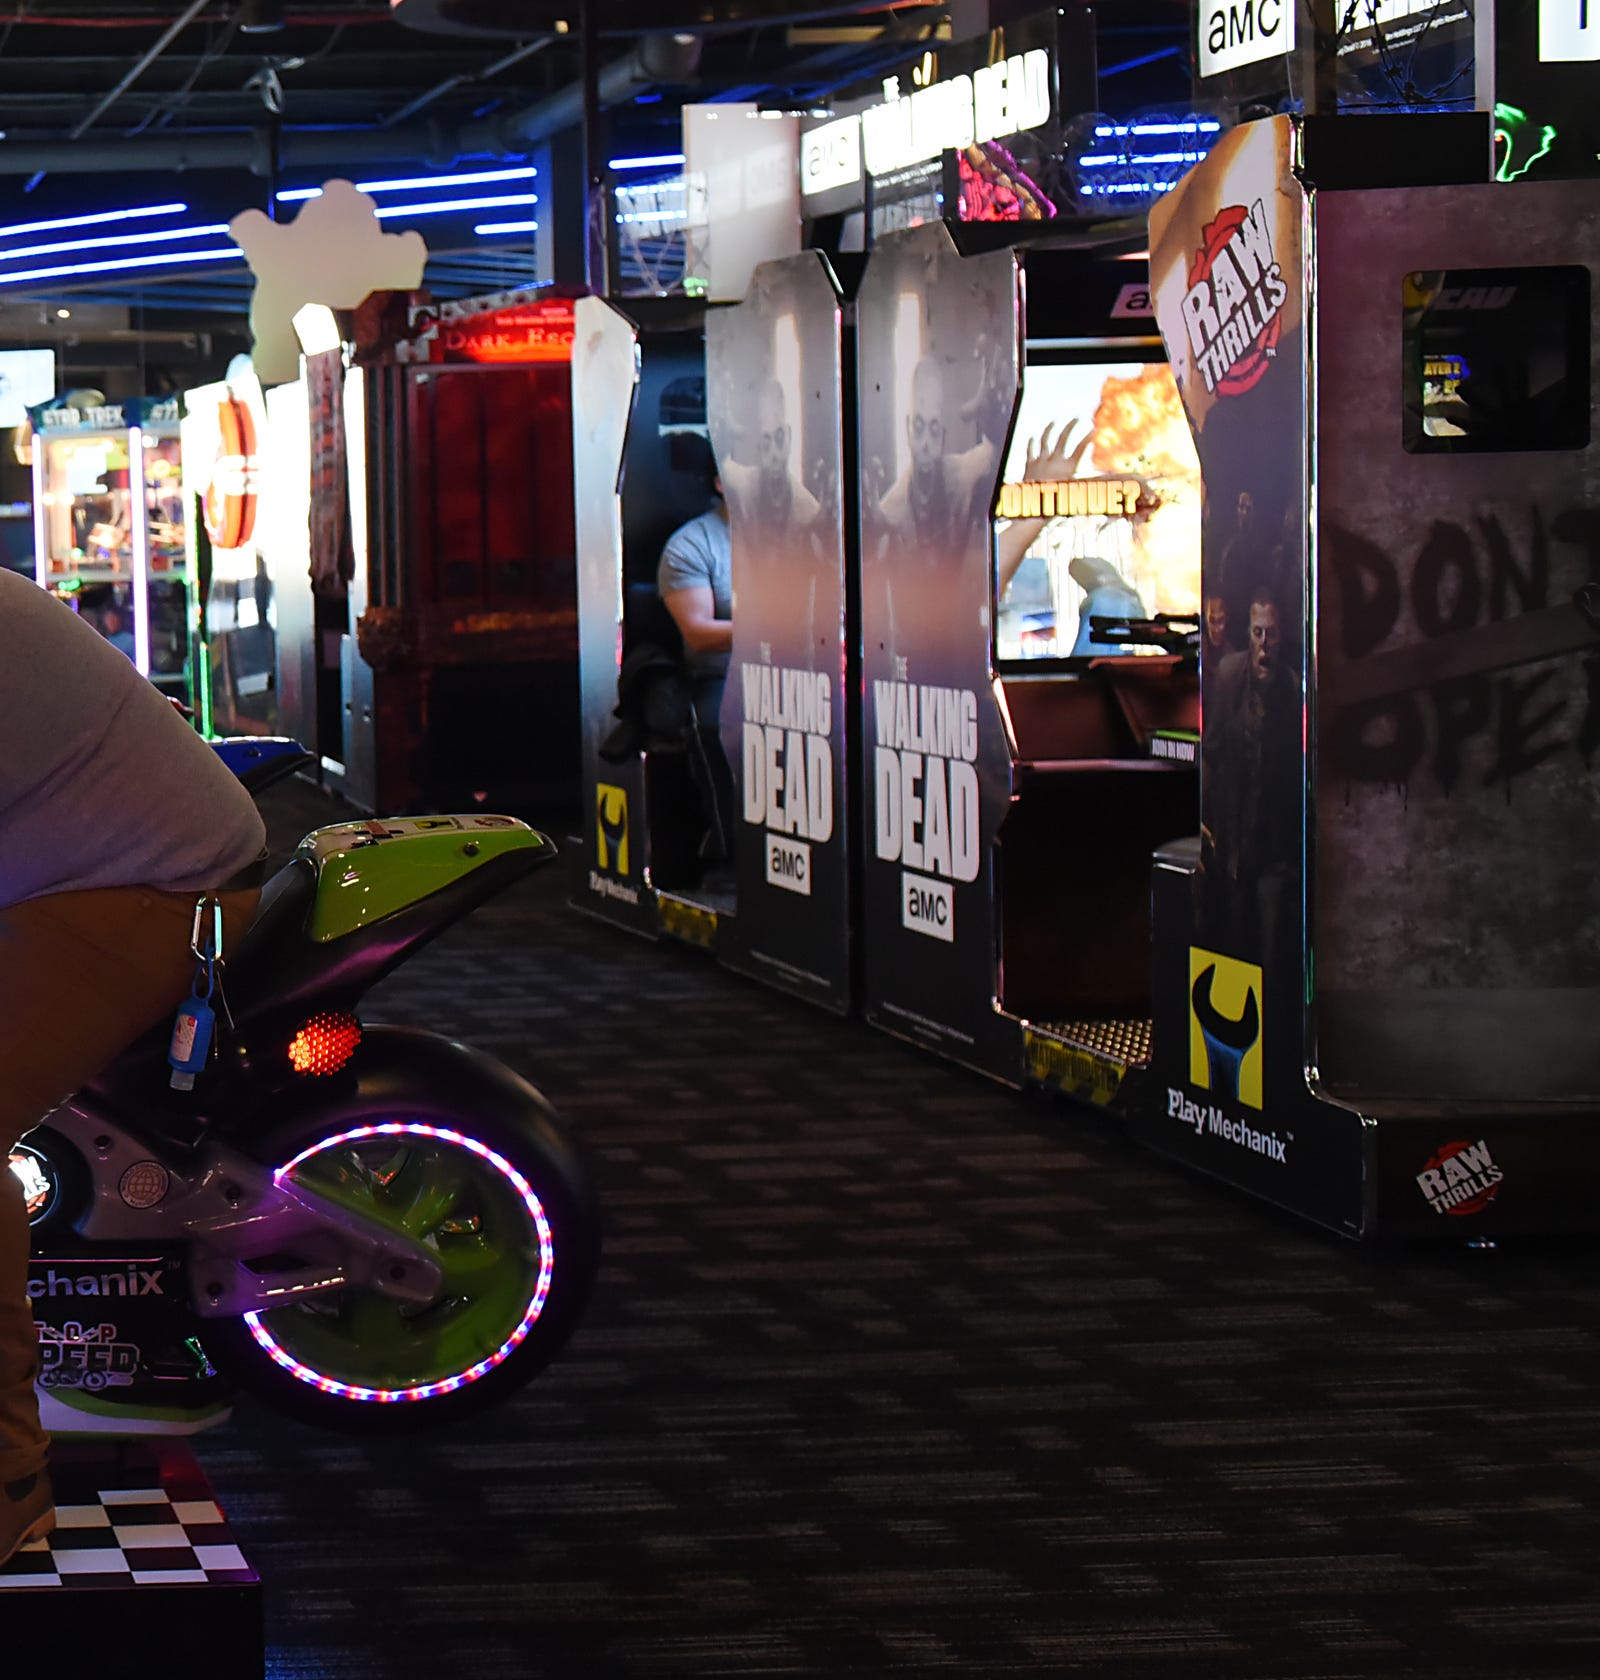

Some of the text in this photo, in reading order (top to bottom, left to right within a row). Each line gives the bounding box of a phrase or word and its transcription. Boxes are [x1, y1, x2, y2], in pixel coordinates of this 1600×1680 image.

[974, 49, 1050, 143] DEAD
[1181, 198, 1274, 359] RAW
[446, 331, 510, 350] DARK
[1197, 262, 1287, 393] THRILLS
[1424, 362, 1451, 376] AYER
[86, 405, 124, 430] TREK
[742, 662, 832, 737] WALKING
[873, 679, 978, 763] WALKING
[743, 722, 833, 843] DEAD
[1168, 740, 1176, 759] IN
[1177, 741, 1195, 762] NOW
[874, 746, 980, 883] DEAD
[1168, 1087, 1207, 1135] Play
[1209, 1105, 1287, 1163] Mechanix
[1416, 1139, 1494, 1201] RAW
[1429, 1165, 1504, 1214] THRILLS
[27, 1264, 163, 1296] chanix
[36, 1342, 140, 1376] PEED
